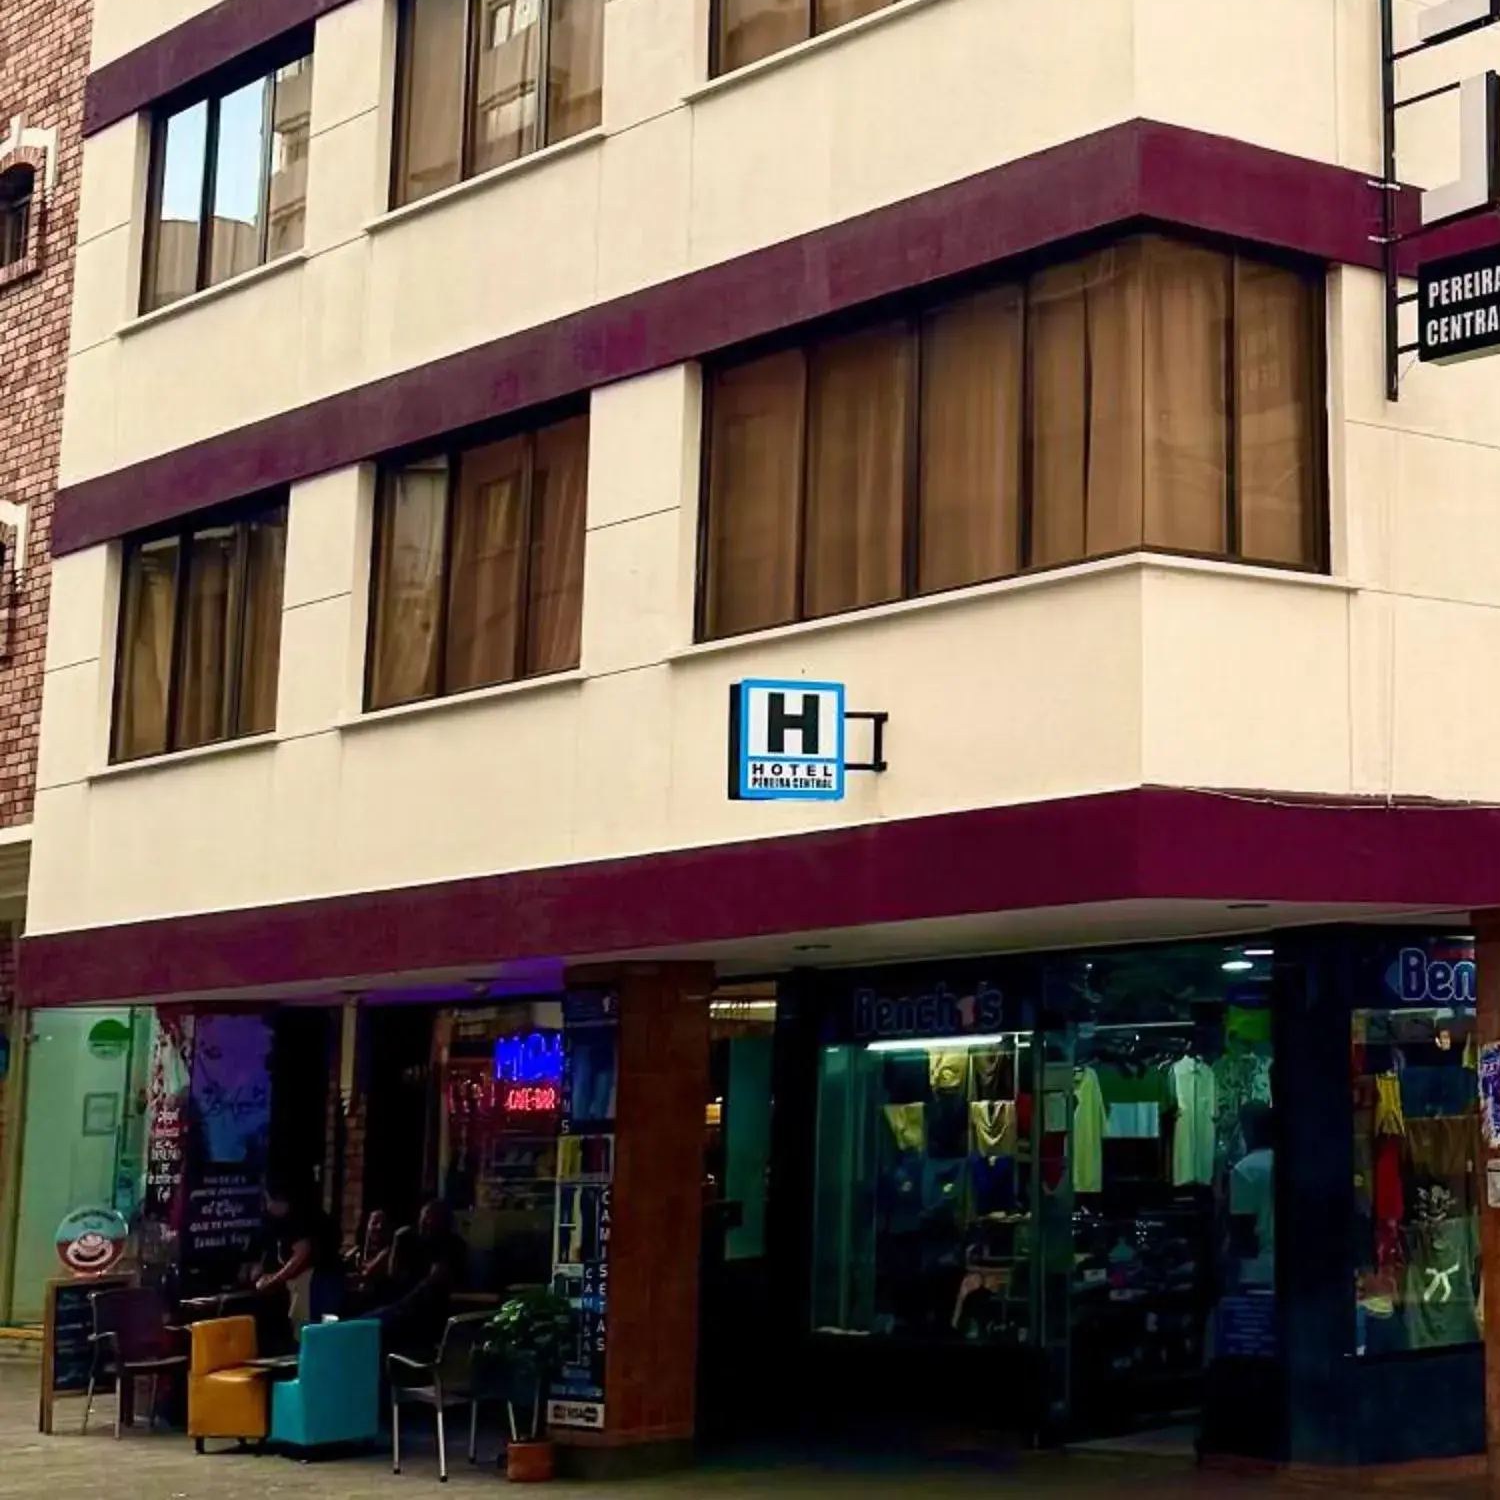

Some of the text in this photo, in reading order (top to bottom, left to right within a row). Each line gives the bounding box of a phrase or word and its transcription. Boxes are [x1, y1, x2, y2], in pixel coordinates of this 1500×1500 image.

[767, 692, 820, 754] H
[752, 763, 833, 777] HOTEL
[1399, 946, 1477, 1002] Ben
